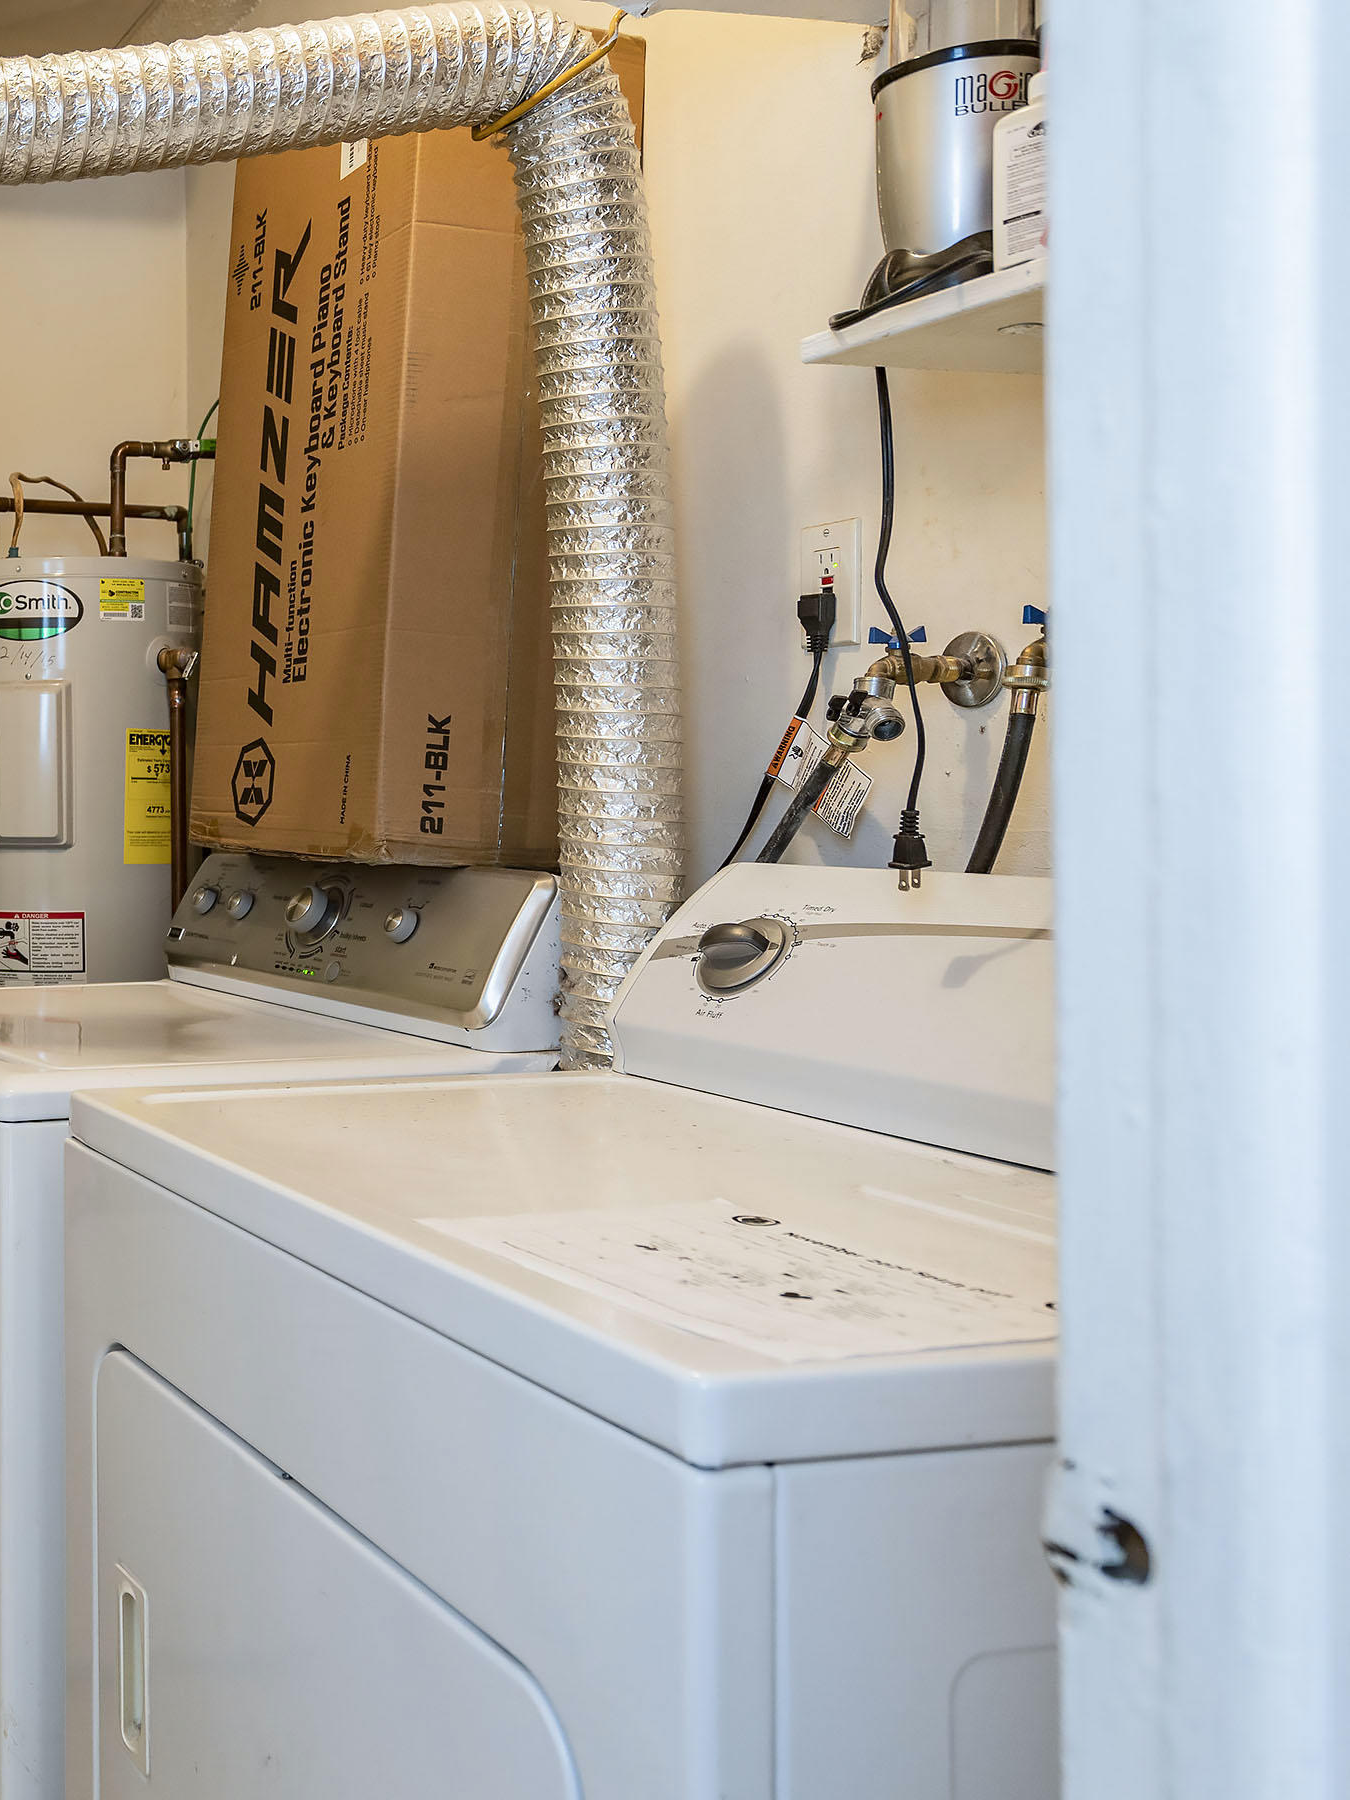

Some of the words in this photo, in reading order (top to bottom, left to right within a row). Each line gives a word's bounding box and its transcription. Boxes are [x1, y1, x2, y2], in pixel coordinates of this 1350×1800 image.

[954, 100, 1029, 117] BULLE
[371, 146, 379, 192] keyboard
[333, 195, 351, 280] Stand
[368, 192, 376, 242] electronic
[250, 207, 268, 311] 211-BLK
[311, 262, 333, 354] Piano
[323, 282, 346, 421] Keyboard
[363, 336, 372, 397] headphones
[300, 351, 326, 514] Keyboard
[338, 392, 349, 451] Package
[354, 379, 363, 435] Detachable
[321, 425, 335, 450] &
[247, 217, 312, 728] HAMZER
[281, 559, 298, 684] Multi-function
[291, 519, 315, 683] Electronic
[153, 763, 171, 774] 573
[343, 754, 352, 784] CHINA
[774, 725, 796, 762] WARNING
[342, 785, 348, 796] IN
[420, 713, 452, 835] 211-BLK
[146, 805, 165, 814] 4773
[339, 798, 347, 825] MADE
